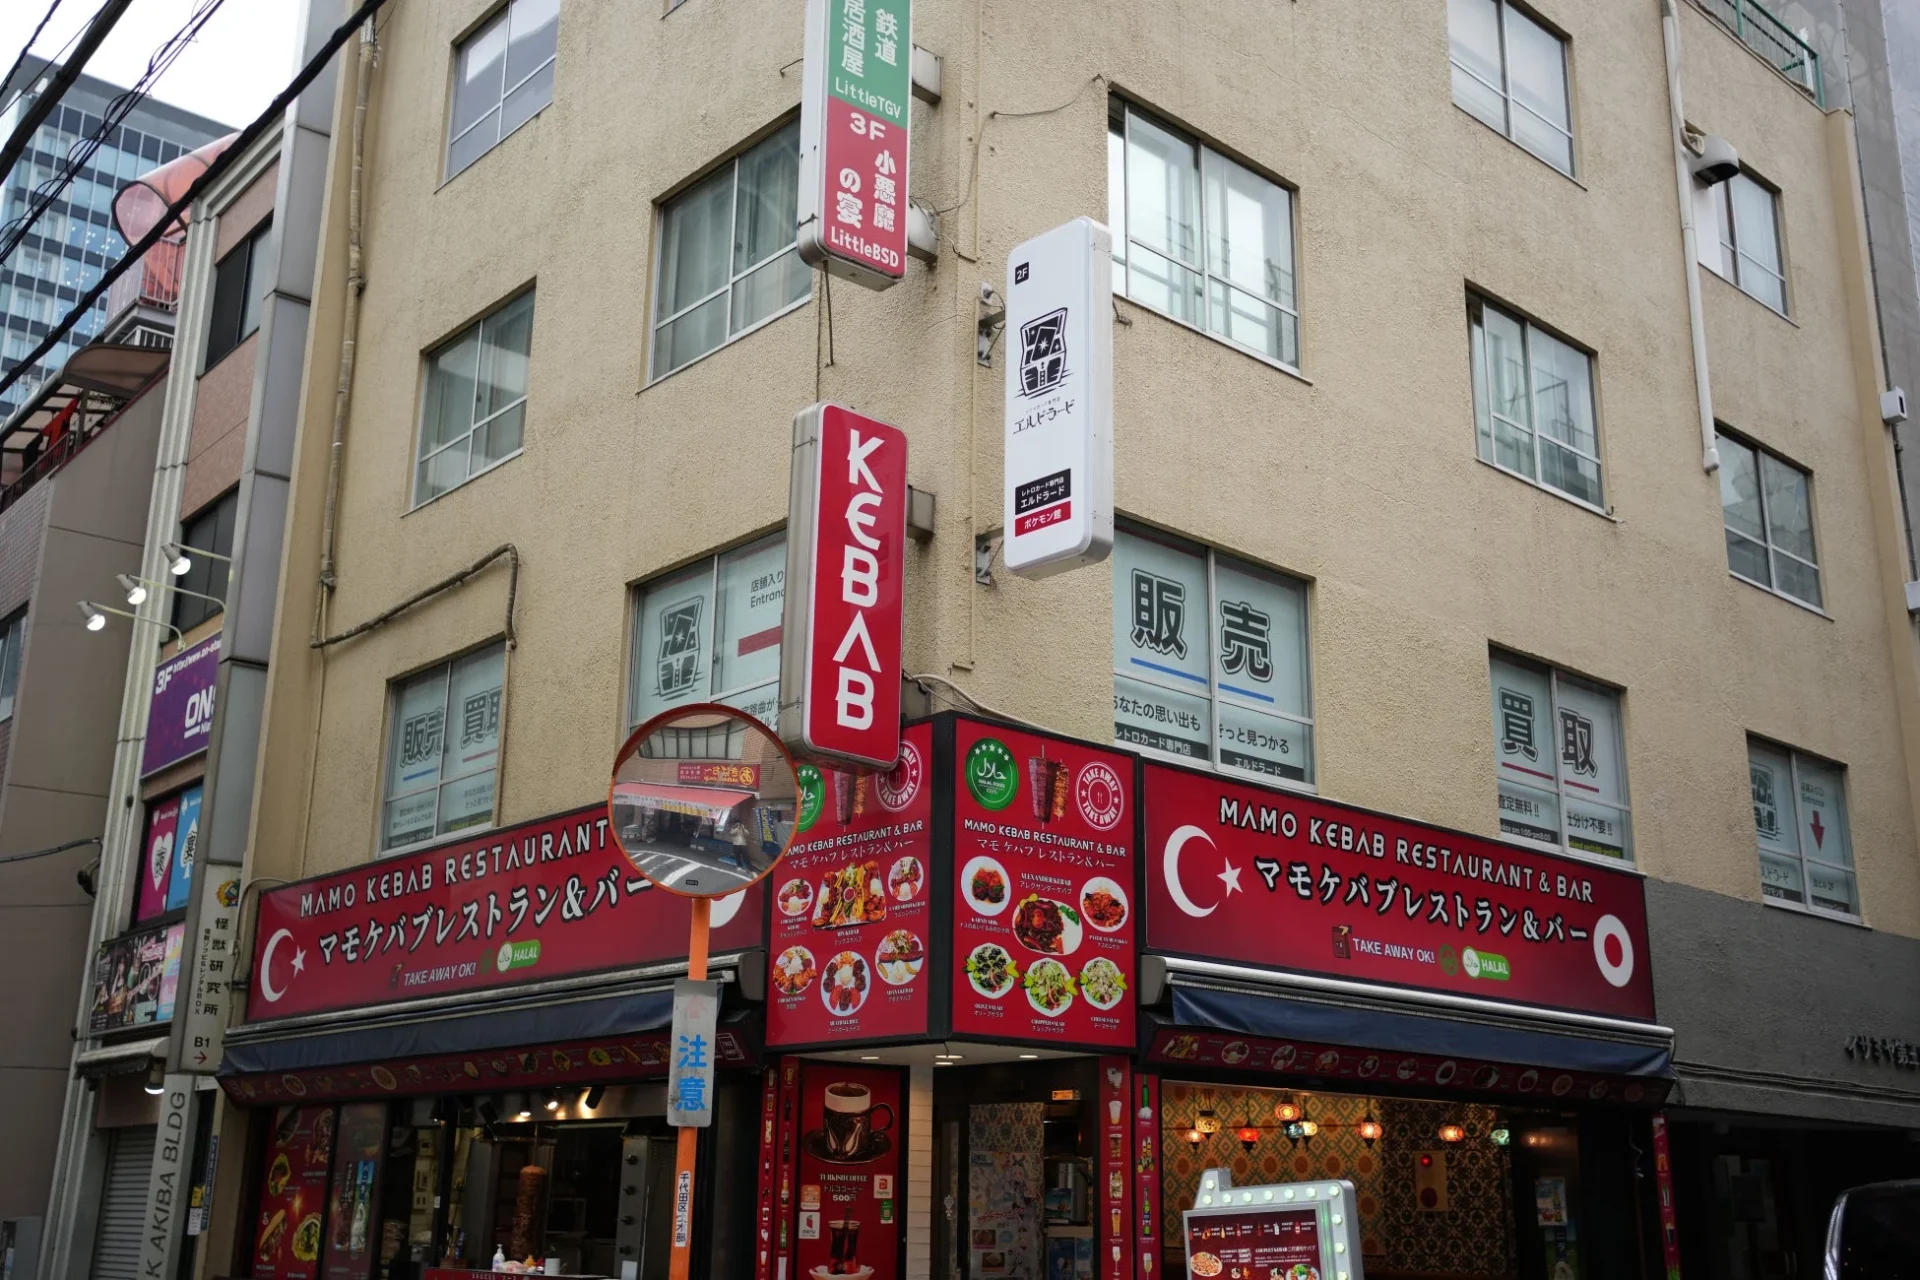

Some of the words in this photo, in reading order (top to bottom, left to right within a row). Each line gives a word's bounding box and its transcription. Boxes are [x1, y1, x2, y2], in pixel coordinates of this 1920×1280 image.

[841, 0, 867, 78] 居酒屋
[875, 8, 898, 67] 鉄道
[835, 77, 901, 119] LittleTGV
[850, 113, 886, 140] 3F
[836, 168, 863, 229] の宴
[874, 150, 897, 232] 小悪魔
[831, 226, 899, 268] LittleBSD
[1016, 267, 1028, 281] 2F
[1013, 399, 1075, 434] エルドラード
[1020, 485, 1065, 508] エルドラード
[1021, 476, 1064, 497] レトロカード専門店
[1024, 508, 1061, 529] ポケモン館
[833, 429, 885, 730] KEBAB
[1131, 568, 1273, 683] 販売
[155, 665, 173, 695] 3F
[184, 684, 216, 728] ON
[1499, 687, 1597, 778] 買取
[1083, 768, 1099, 785] TAKE
[1099, 768, 1119, 792] AWAY
[1234, 757, 1282, 776] エルドラード
[1083, 801, 1099, 823] TAKE
[1099, 808, 1119, 825] AWAY
[807, 838, 834, 853] KEBAB
[836, 826, 892, 847] RESTAURANT
[893, 825, 902, 836] &
[903, 820, 923, 834] BAR
[964, 819, 996, 834] MAMO
[998, 824, 1031, 840] KEBAB
[1033, 831, 1094, 851] RESTAURANT
[1096, 842, 1104, 853] &
[1106, 845, 1126, 857] BAR
[1220, 798, 1297, 838] MAMO
[1309, 818, 1385, 858] KEBAB
[1396, 839, 1533, 889] RESTAURANT
[1539, 871, 1551, 893] &
[1557, 875, 1594, 902] BAR
[300, 884, 356, 917] MAMO
[367, 863, 433, 903] KEBAB
[445, 818, 608, 884] RESTAURANT
[319, 866, 652, 965] マモケバブレストラン&バー
[1255, 859, 1588, 940] マモケバブレストラン&バー
[512, 946, 538, 962] HALAL
[1353, 938, 1381, 955] TAKE
[1384, 943, 1413, 960] AWAY
[1417, 949, 1436, 964] OK!
[1481, 959, 1508, 974] HALAL
[404, 970, 427, 986] TAKE
[427, 966, 457, 984] AWAY
[458, 962, 476, 978] OK!
[194, 1036, 211, 1049] B1
[676, 1034, 708, 1111] 注意
[162, 1091, 186, 1163] BLDG
[151, 1171, 176, 1254] AKIBA
[832, 1194, 856, 1202] 500円
